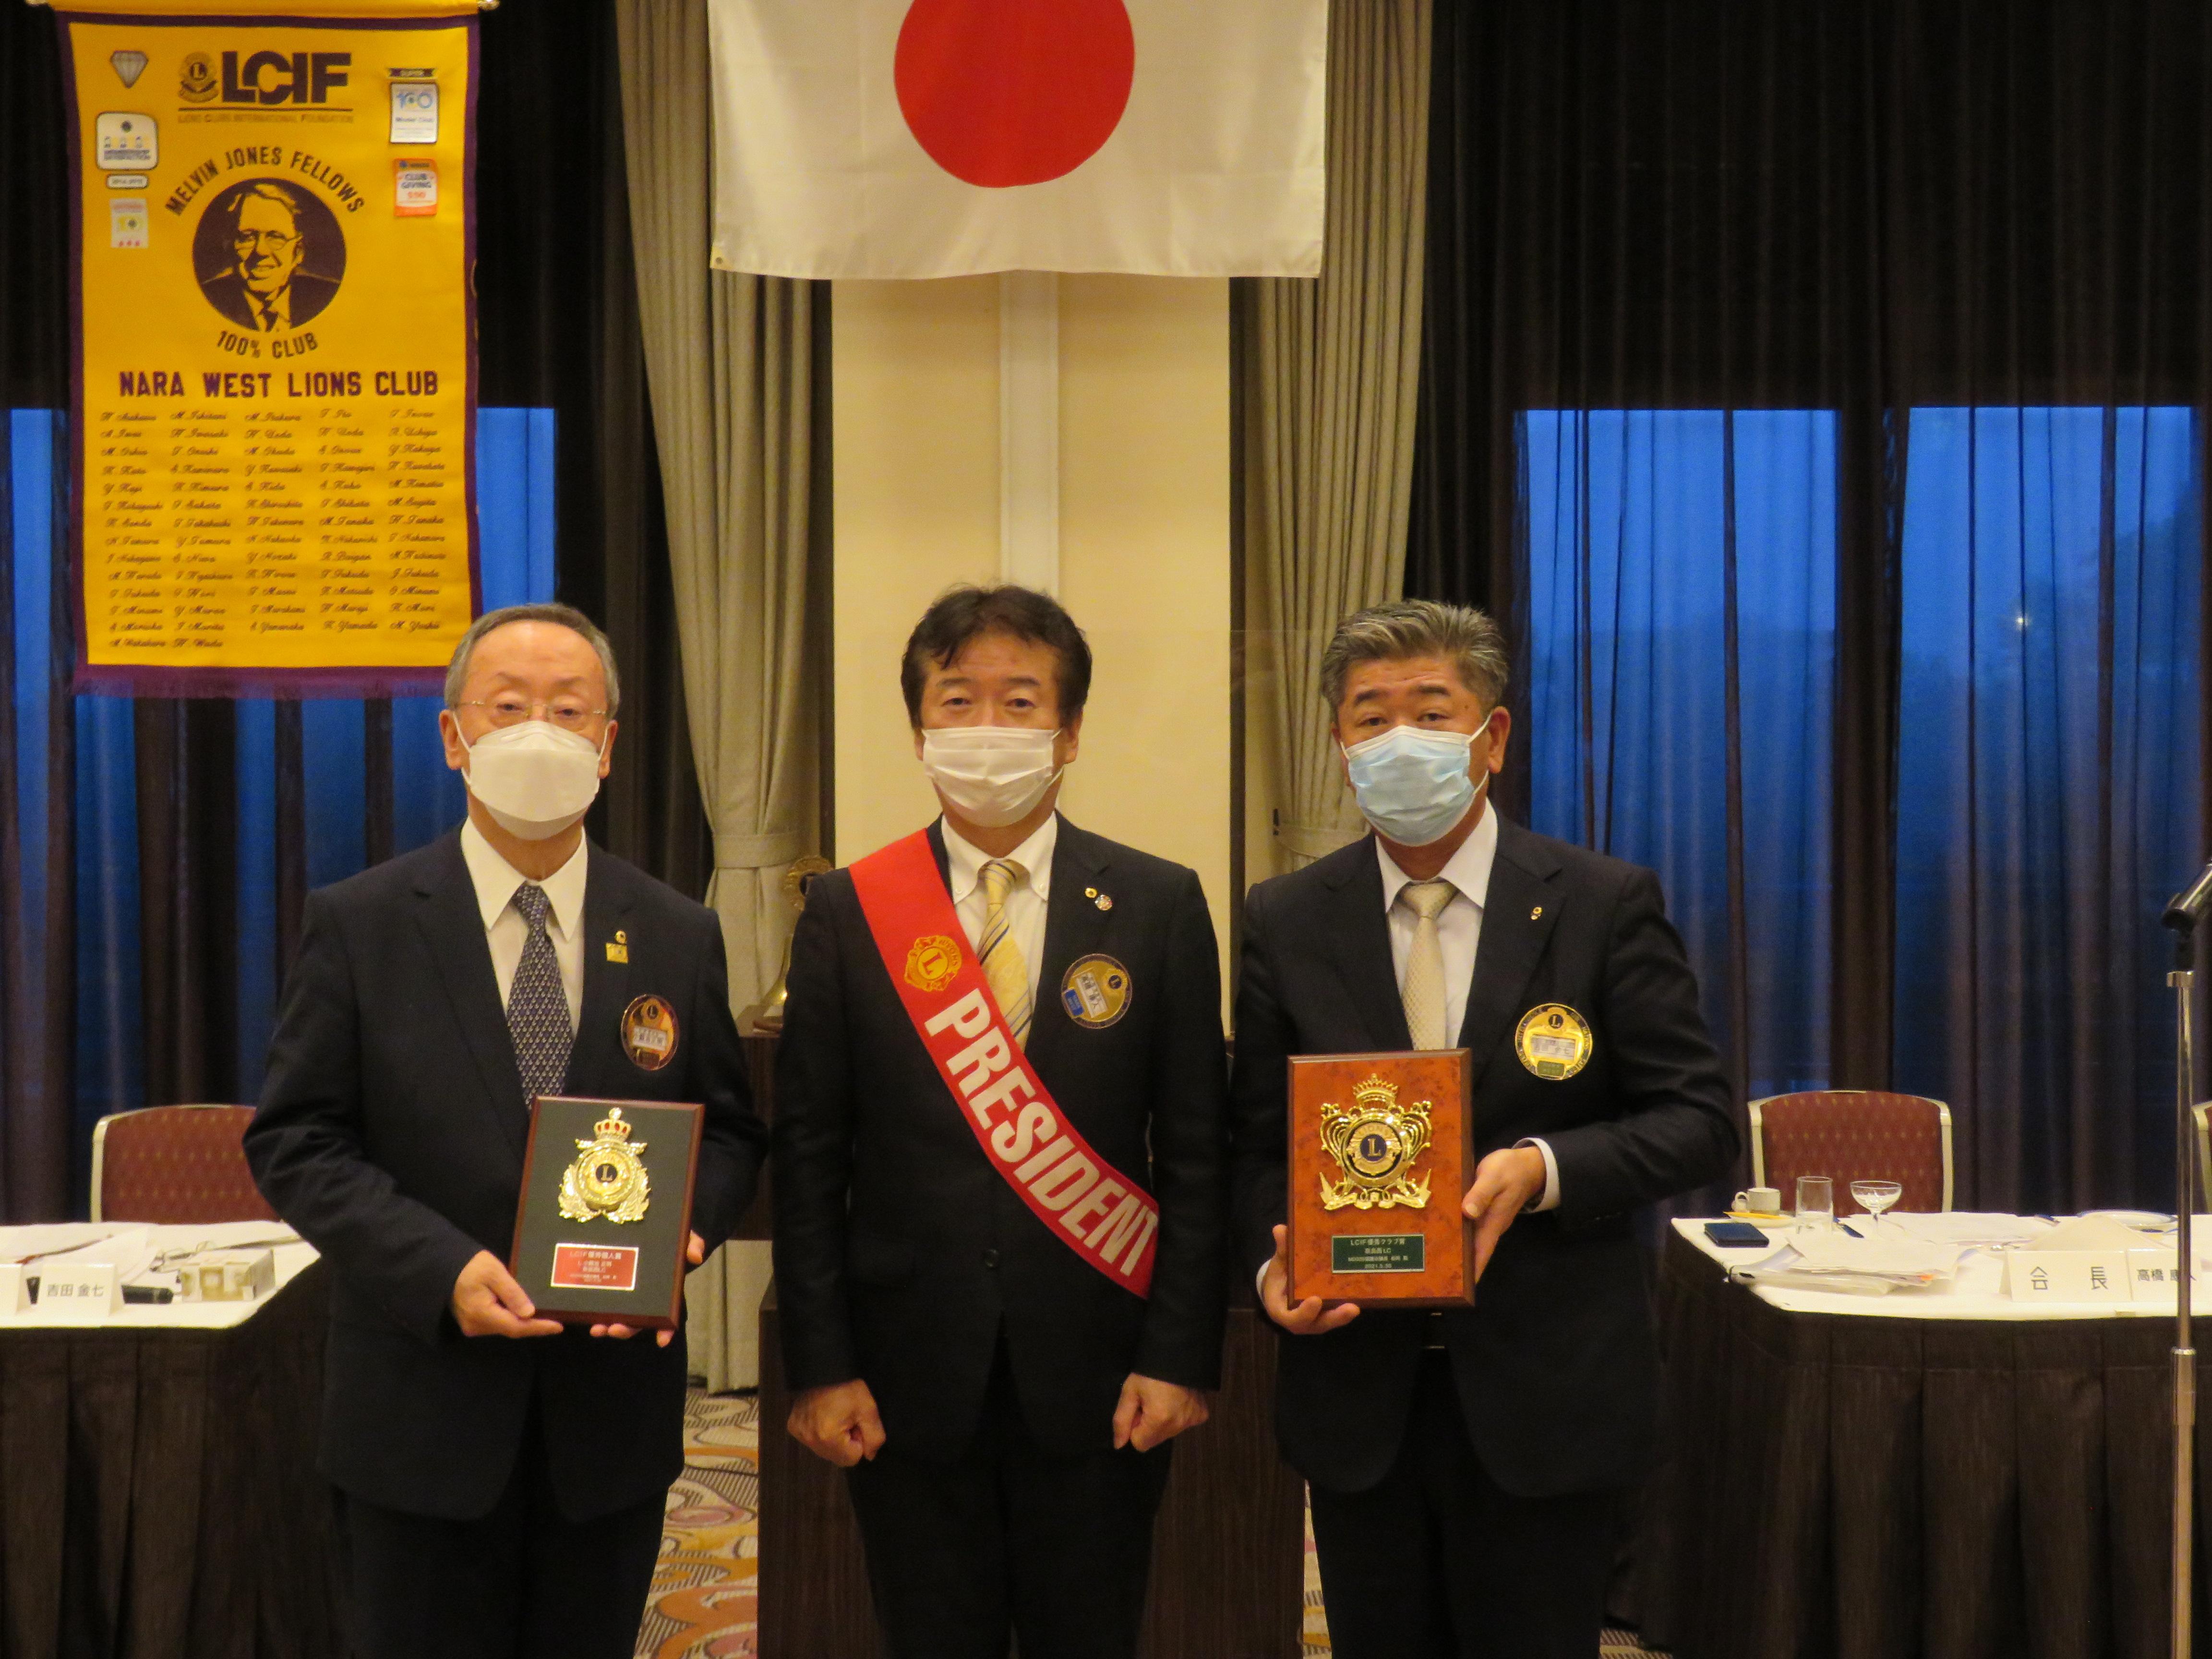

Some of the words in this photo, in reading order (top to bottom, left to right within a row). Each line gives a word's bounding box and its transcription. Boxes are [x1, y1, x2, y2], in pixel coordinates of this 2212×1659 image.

[222, 50, 352, 105] LCIF
[165, 158, 220, 216] MELVIN
[225, 145, 282, 170] JONES
[289, 150, 365, 213] FELLOWS
[217, 330, 260, 359] 100%
[271, 332, 318, 359] CLUB
[119, 371, 185, 397] NARA
[202, 372, 272, 398] WEST
[288, 371, 362, 397] LIONS
[374, 371, 439, 396] CLUB
[924, 987, 1159, 1277] PRESIDENT
